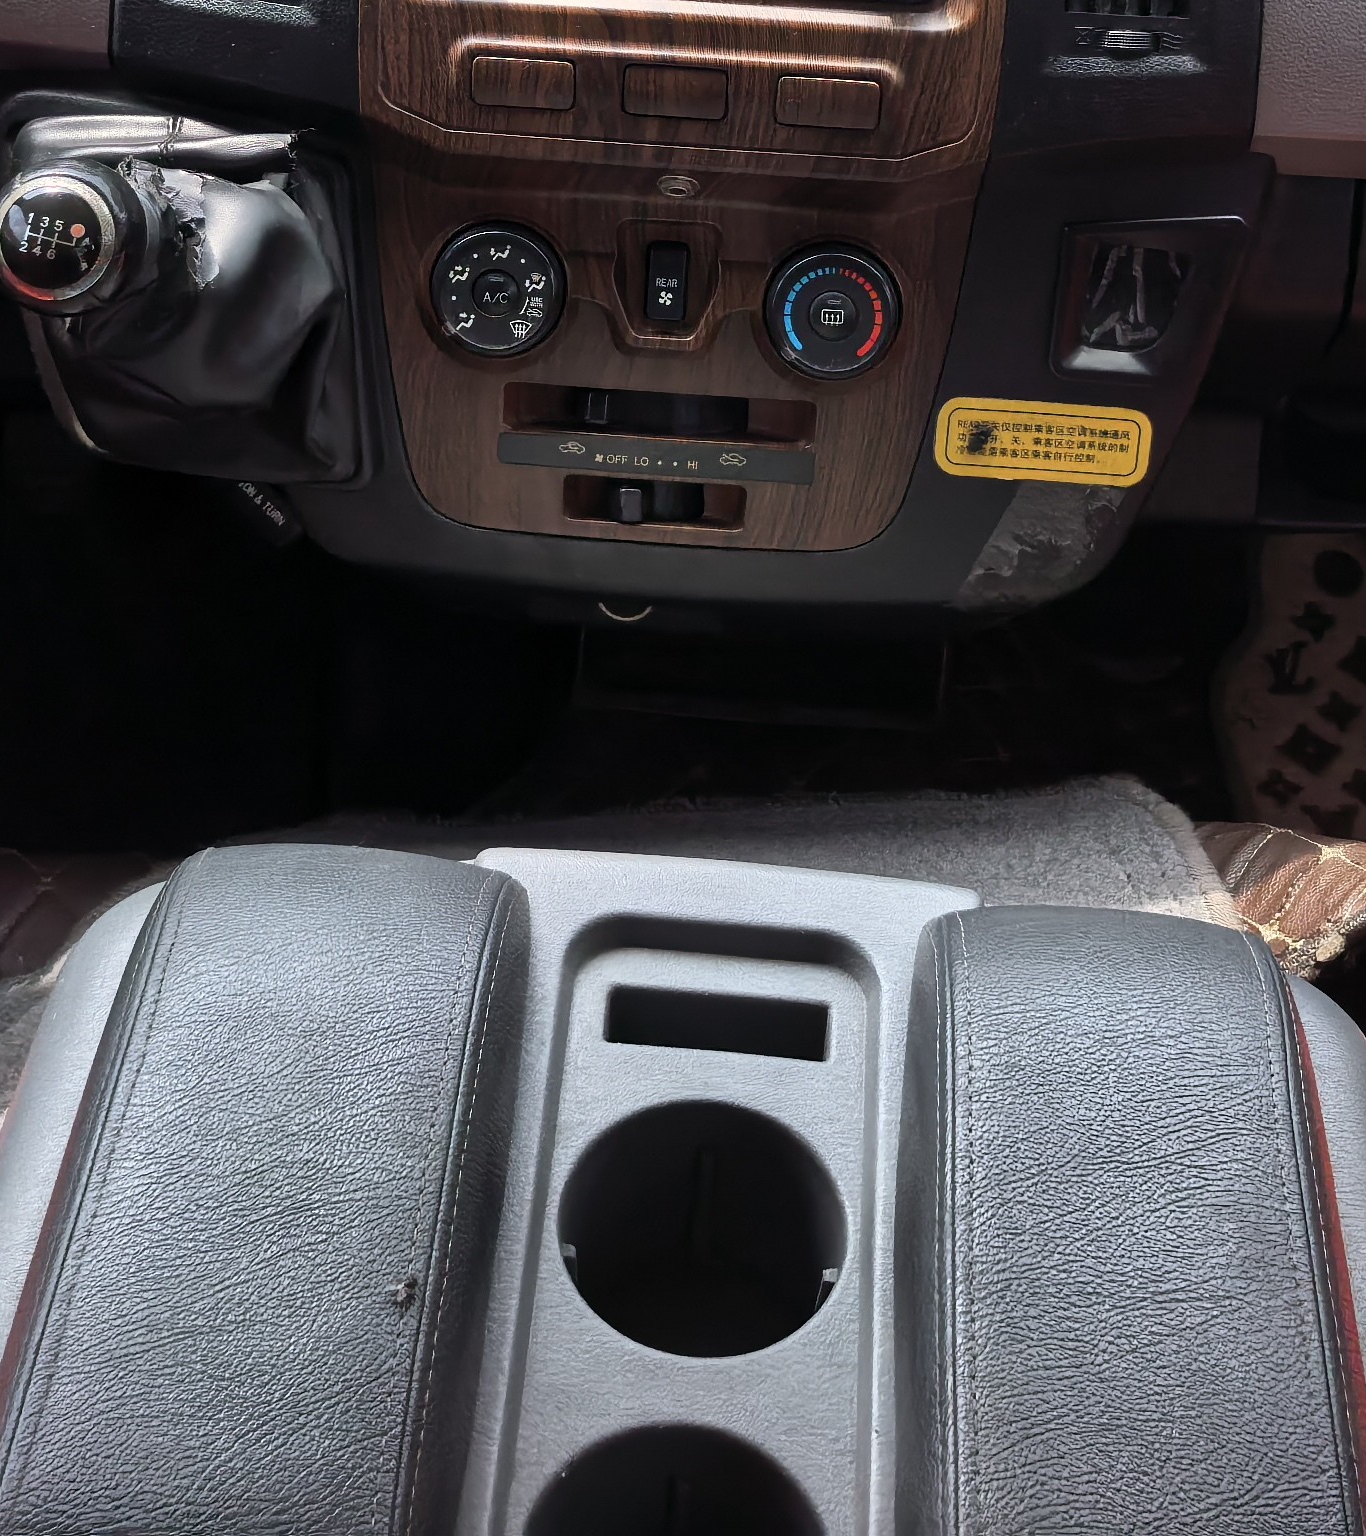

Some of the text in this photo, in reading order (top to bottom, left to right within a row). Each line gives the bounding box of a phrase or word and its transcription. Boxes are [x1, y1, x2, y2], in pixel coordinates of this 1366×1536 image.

[27, 212, 65, 231] 1 3 5
[18, 240, 56, 260] 2 4 6
[655, 277, 678, 288] REAR
[482, 291, 508, 304] A/C
[606, 454, 699, 470] OFF LO HI
[262, 501, 286, 526] TURN
